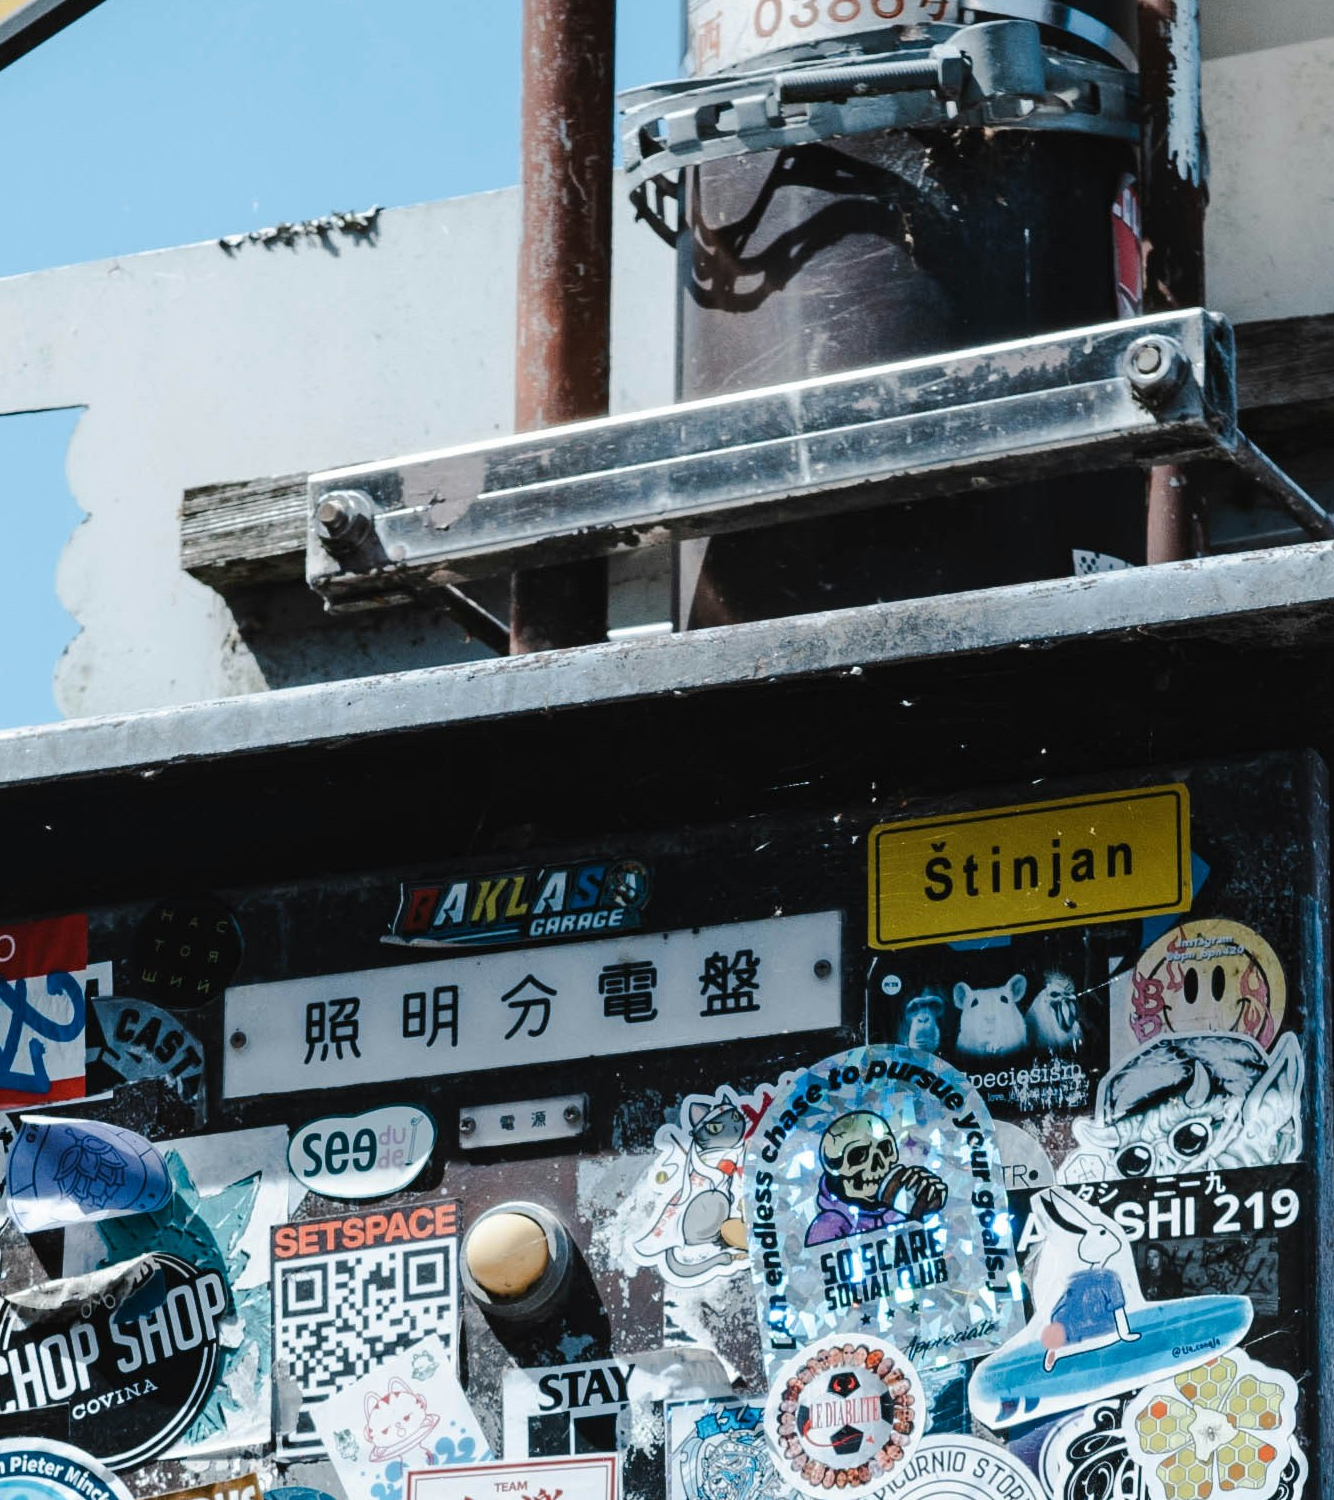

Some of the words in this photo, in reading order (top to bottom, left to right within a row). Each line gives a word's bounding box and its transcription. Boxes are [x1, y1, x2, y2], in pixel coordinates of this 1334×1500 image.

[924, 841, 1133, 902] Štinjan
[529, 907, 624, 938] GARAGE
[304, 949, 762, 1065] 照明分電盤
[829, 1065, 860, 1090] to
[866, 1060, 964, 1111] pursue
[499, 1109, 547, 1133] 電源
[761, 1083, 823, 1163] chase
[274, 1203, 457, 1258] SETSPACE
[754, 1170, 783, 1286] endless
[1213, 1188, 1300, 1235] 219
[111, 1272, 227, 1374] SHOP
[71, 1379, 159, 1421] COVINA
[538, 1363, 635, 1411] STAY
[10, 1454, 65, 1478] Pieter
[494, 1480, 528, 1494] TEAM
